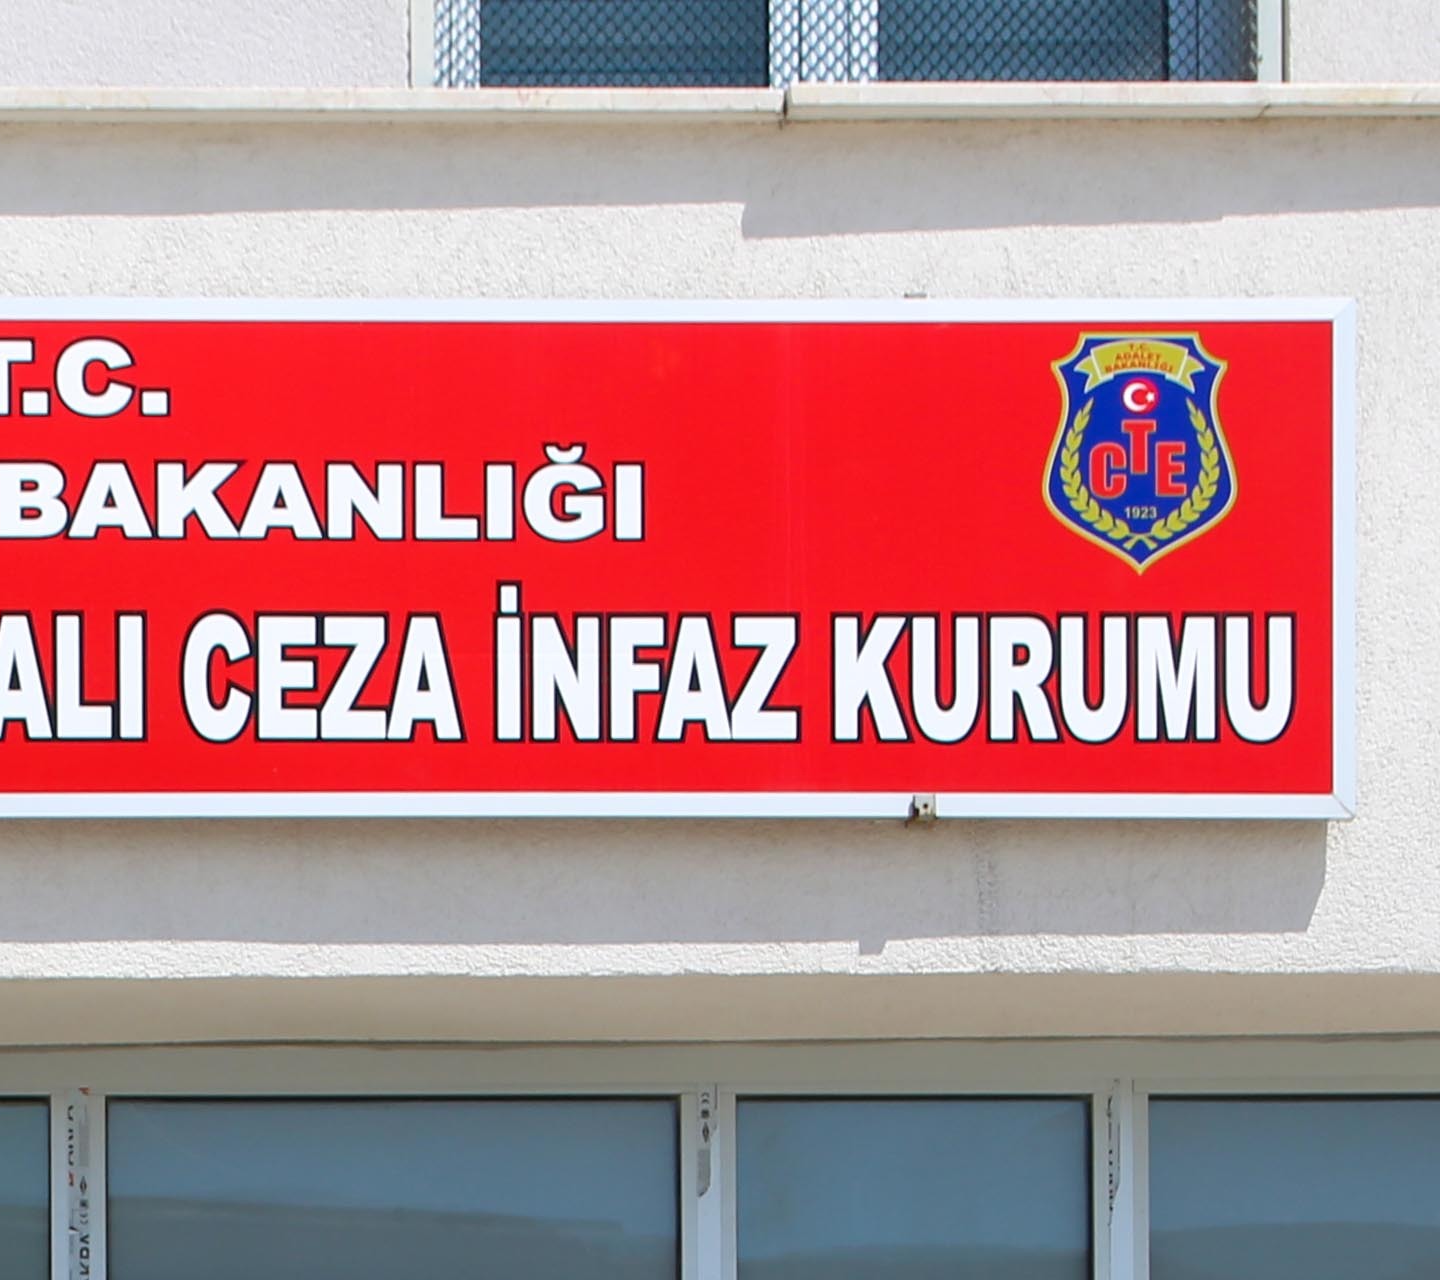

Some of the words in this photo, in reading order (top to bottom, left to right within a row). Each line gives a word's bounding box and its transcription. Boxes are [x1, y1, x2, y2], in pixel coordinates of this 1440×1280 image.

[1089, 419, 1187, 498] CTE
[1124, 506, 1158, 519] 1923
[181, 610, 466, 744] CEZA
[493, 580, 801, 743] İNFAZ
[831, 612, 1297, 743] KURUMU
